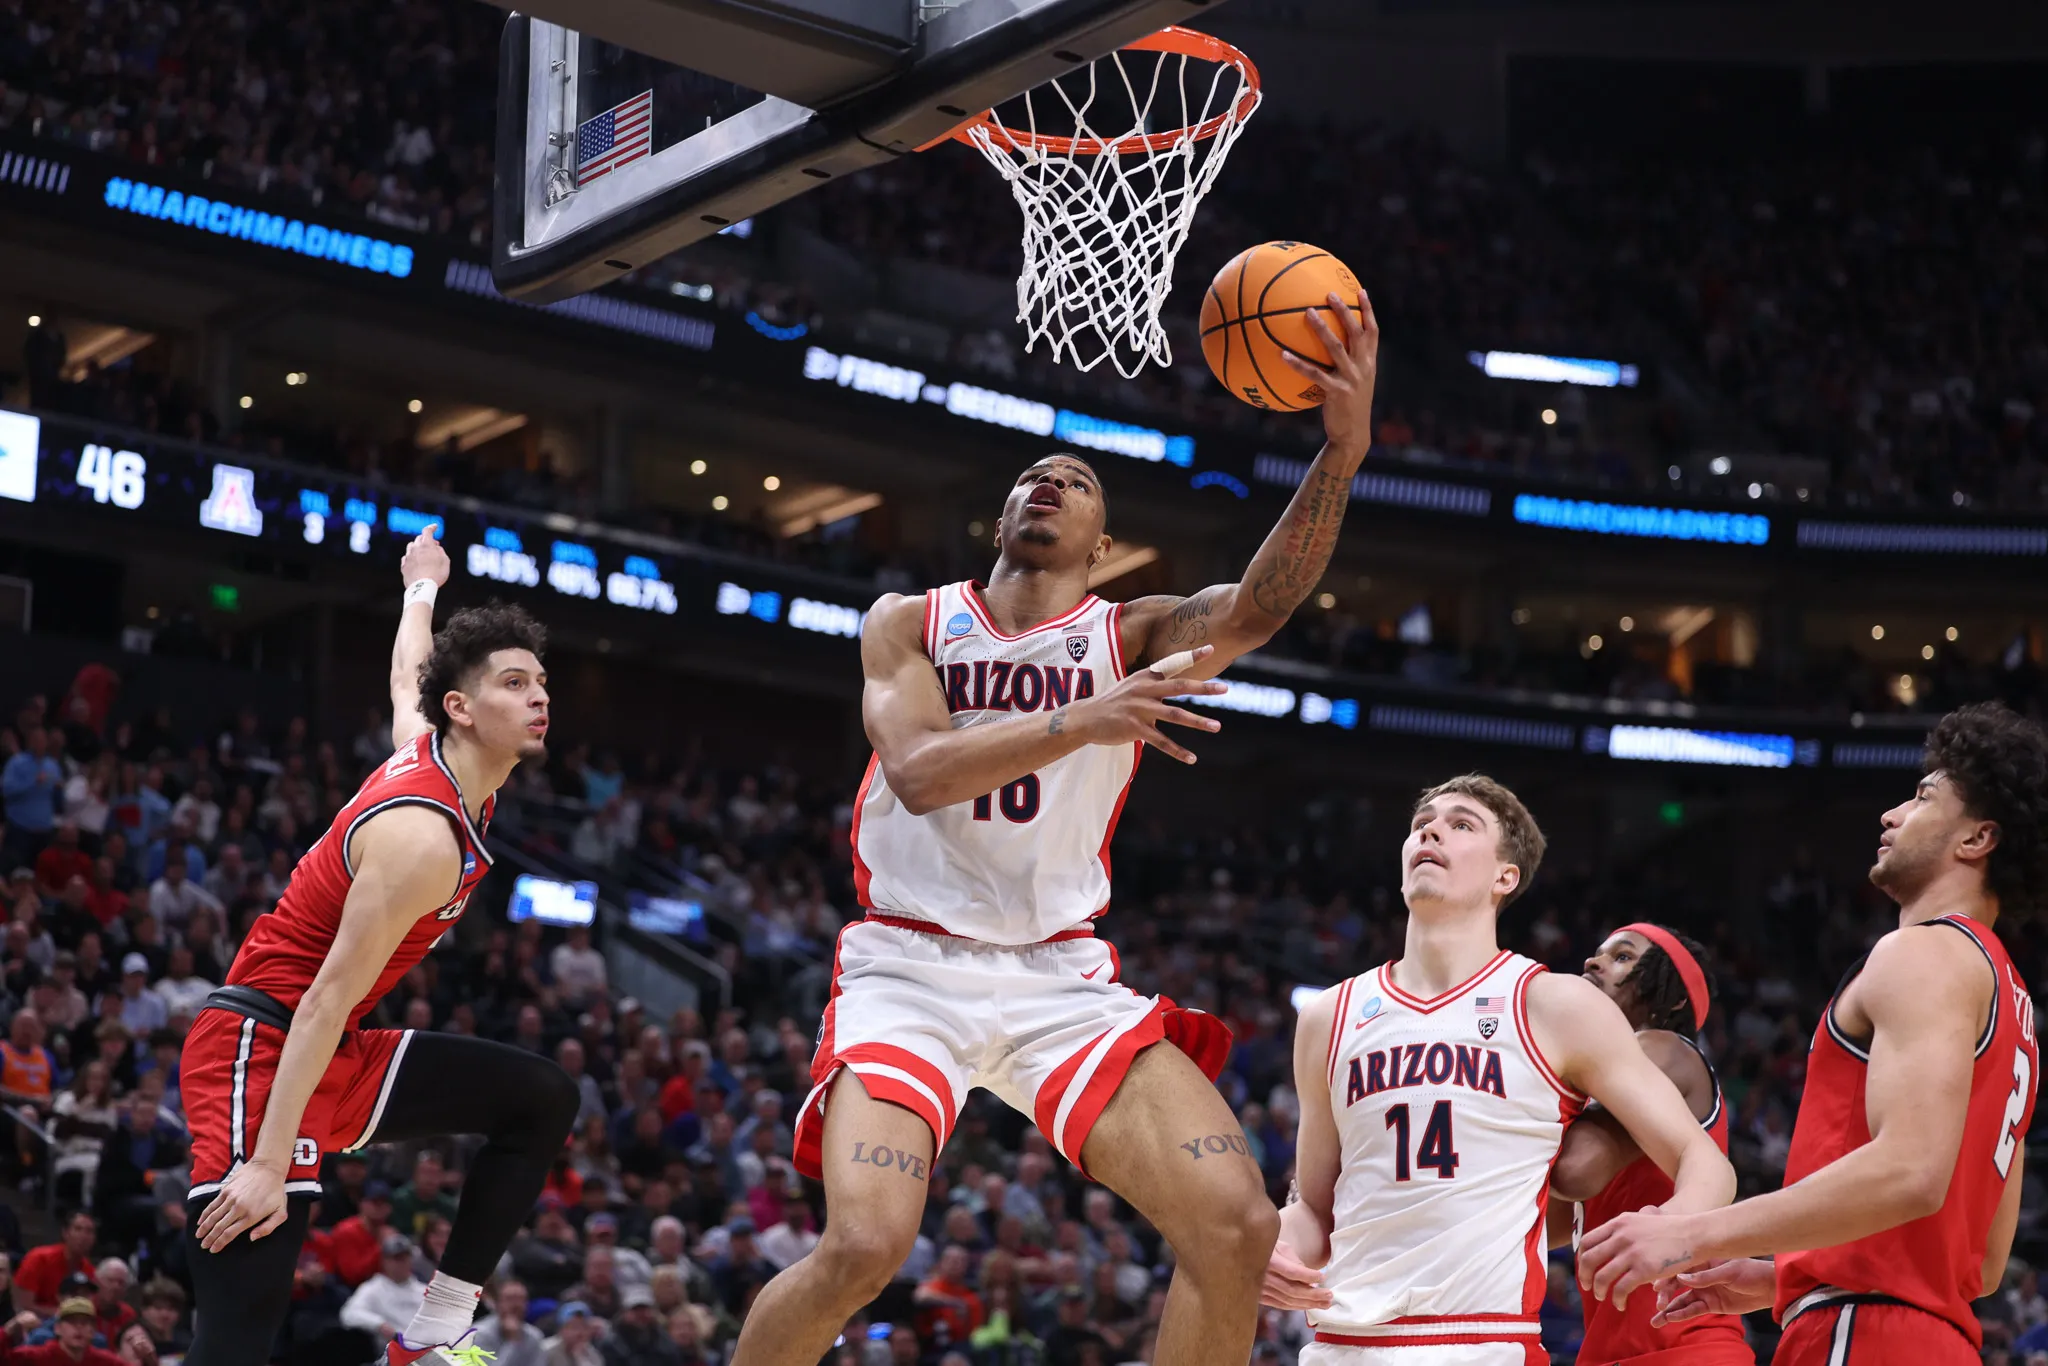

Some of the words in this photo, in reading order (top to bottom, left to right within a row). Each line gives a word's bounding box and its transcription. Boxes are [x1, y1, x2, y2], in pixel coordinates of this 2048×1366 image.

[104, 176, 414, 278] #MARCHMADNESS
[76, 443, 146, 509] 46
[1068, 637, 1087, 652] PAC
[1072, 647, 1084, 658] 12
[937, 660, 1095, 713] RIZONA
[1347, 1042, 1507, 1108] ARIZONA
[1385, 1100, 1459, 1181] 14
[1992, 1044, 2031, 1182] 2
[851, 1142, 926, 1181] LOVE
